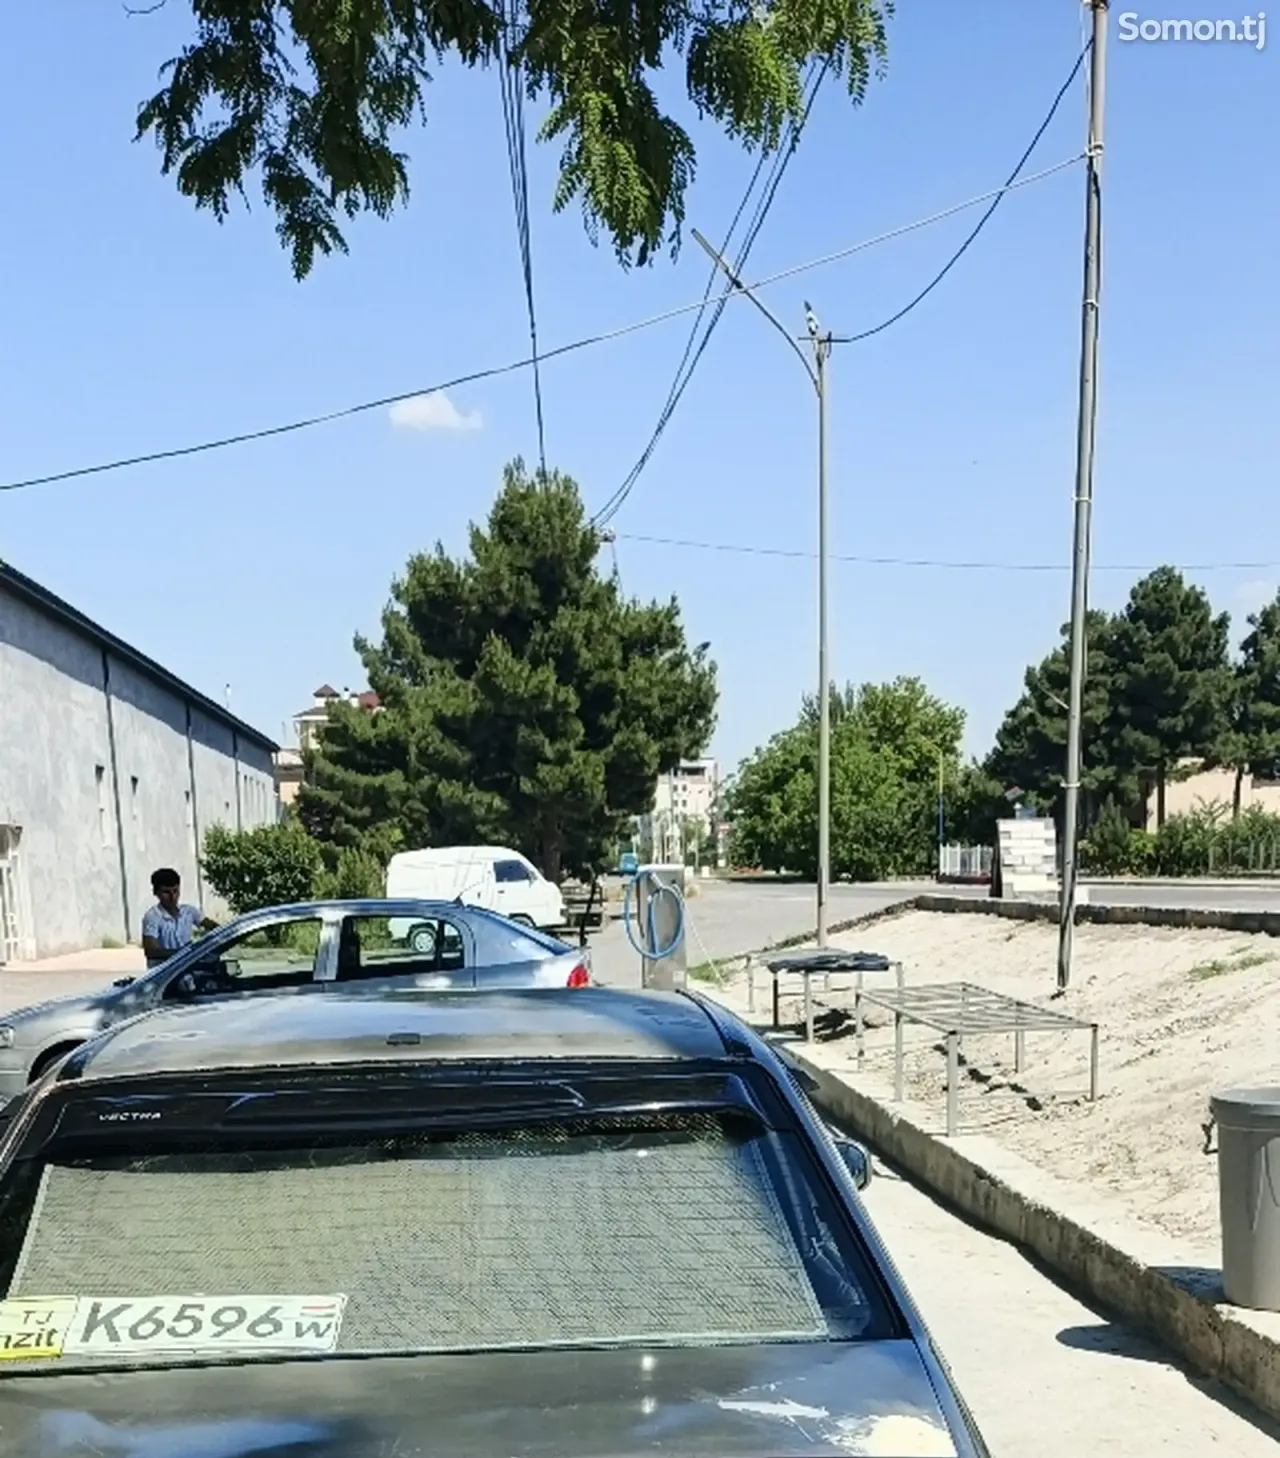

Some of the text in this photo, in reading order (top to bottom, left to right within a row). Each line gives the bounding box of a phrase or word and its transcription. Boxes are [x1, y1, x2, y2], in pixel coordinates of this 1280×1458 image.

[99, 1111, 161, 1121] VECTRA
[23, 1310, 54, 1325] TJ
[80, 1302, 283, 1344] K6596
